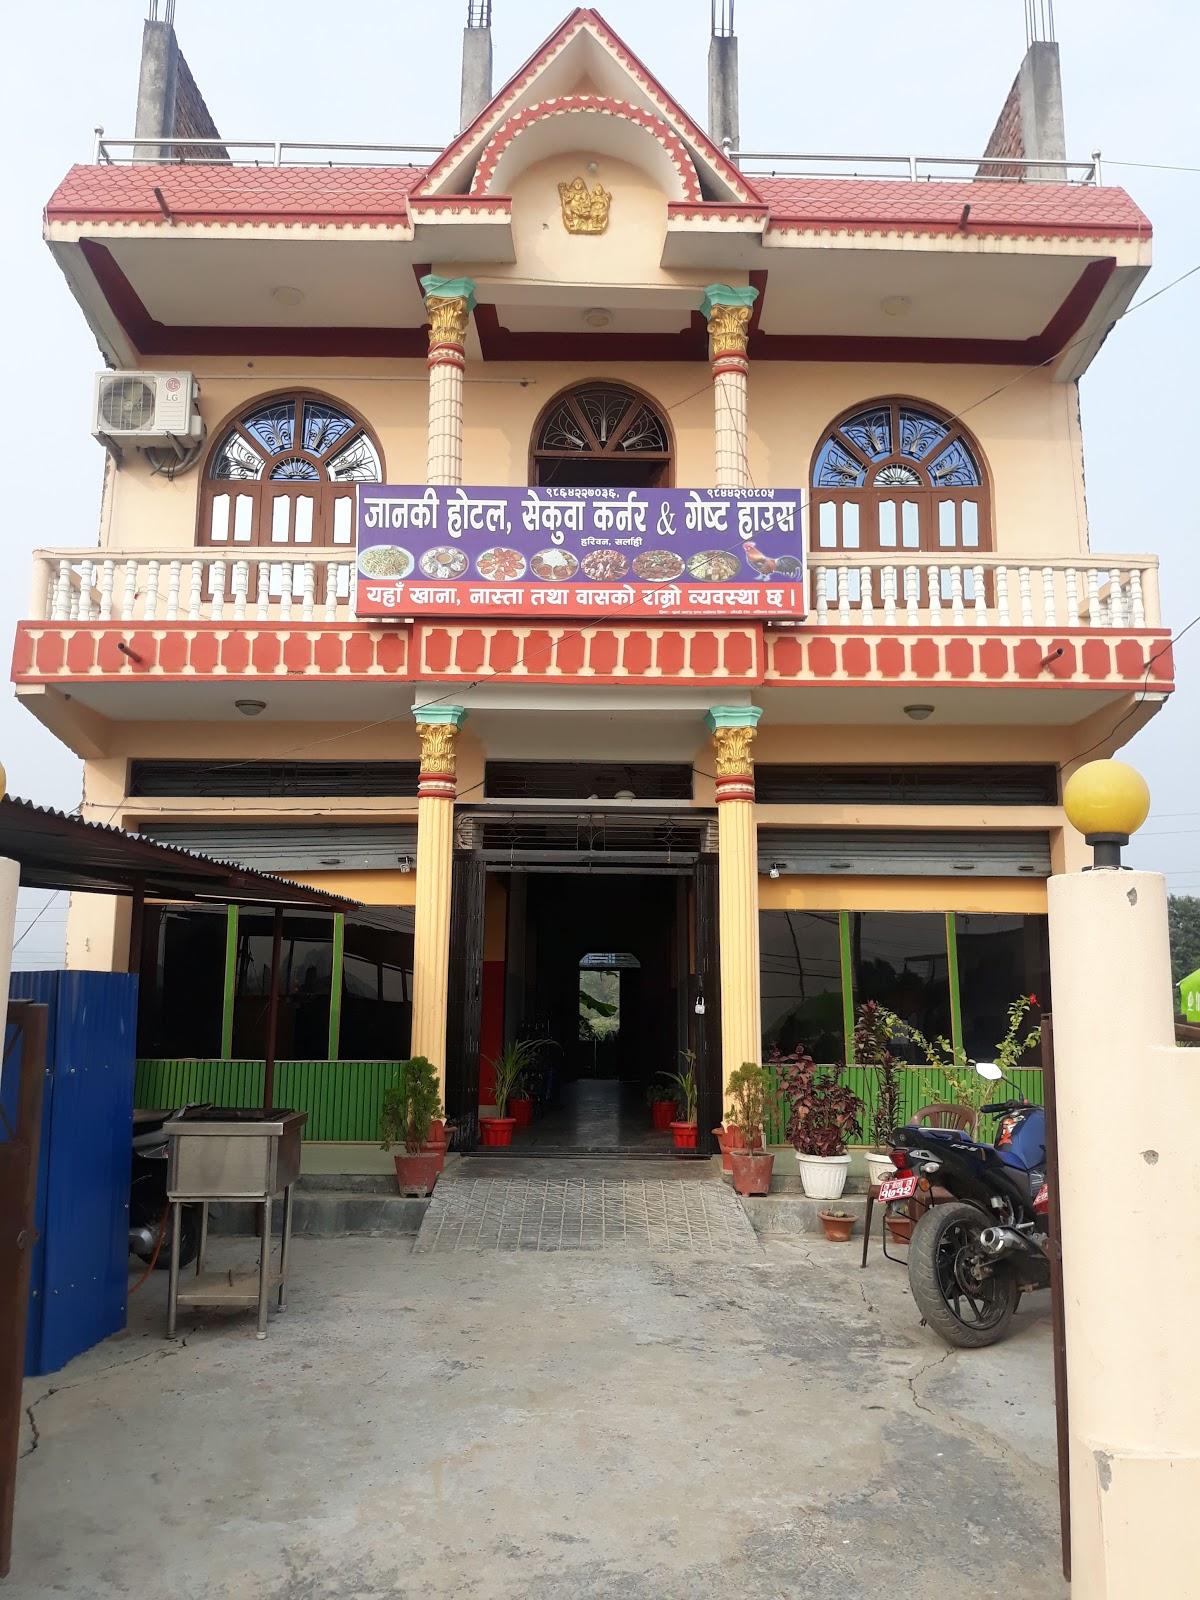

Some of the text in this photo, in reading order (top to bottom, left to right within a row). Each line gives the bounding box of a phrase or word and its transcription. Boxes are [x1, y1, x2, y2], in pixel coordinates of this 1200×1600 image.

[166, 394, 178, 402] LG
[364, 488, 796, 545] जानकी होटल, सेकुवा कर्नर & गेष्ट हाउस
[366, 582, 405, 607] यहाँ
[409, 588, 461, 606] खाना,
[469, 588, 525, 606] नास्ता
[531, 589, 569, 606] तथा
[576, 585, 636, 606] वासको
[642, 585, 682, 608] राम्रो
[688, 589, 760, 606] व्यवस्था
